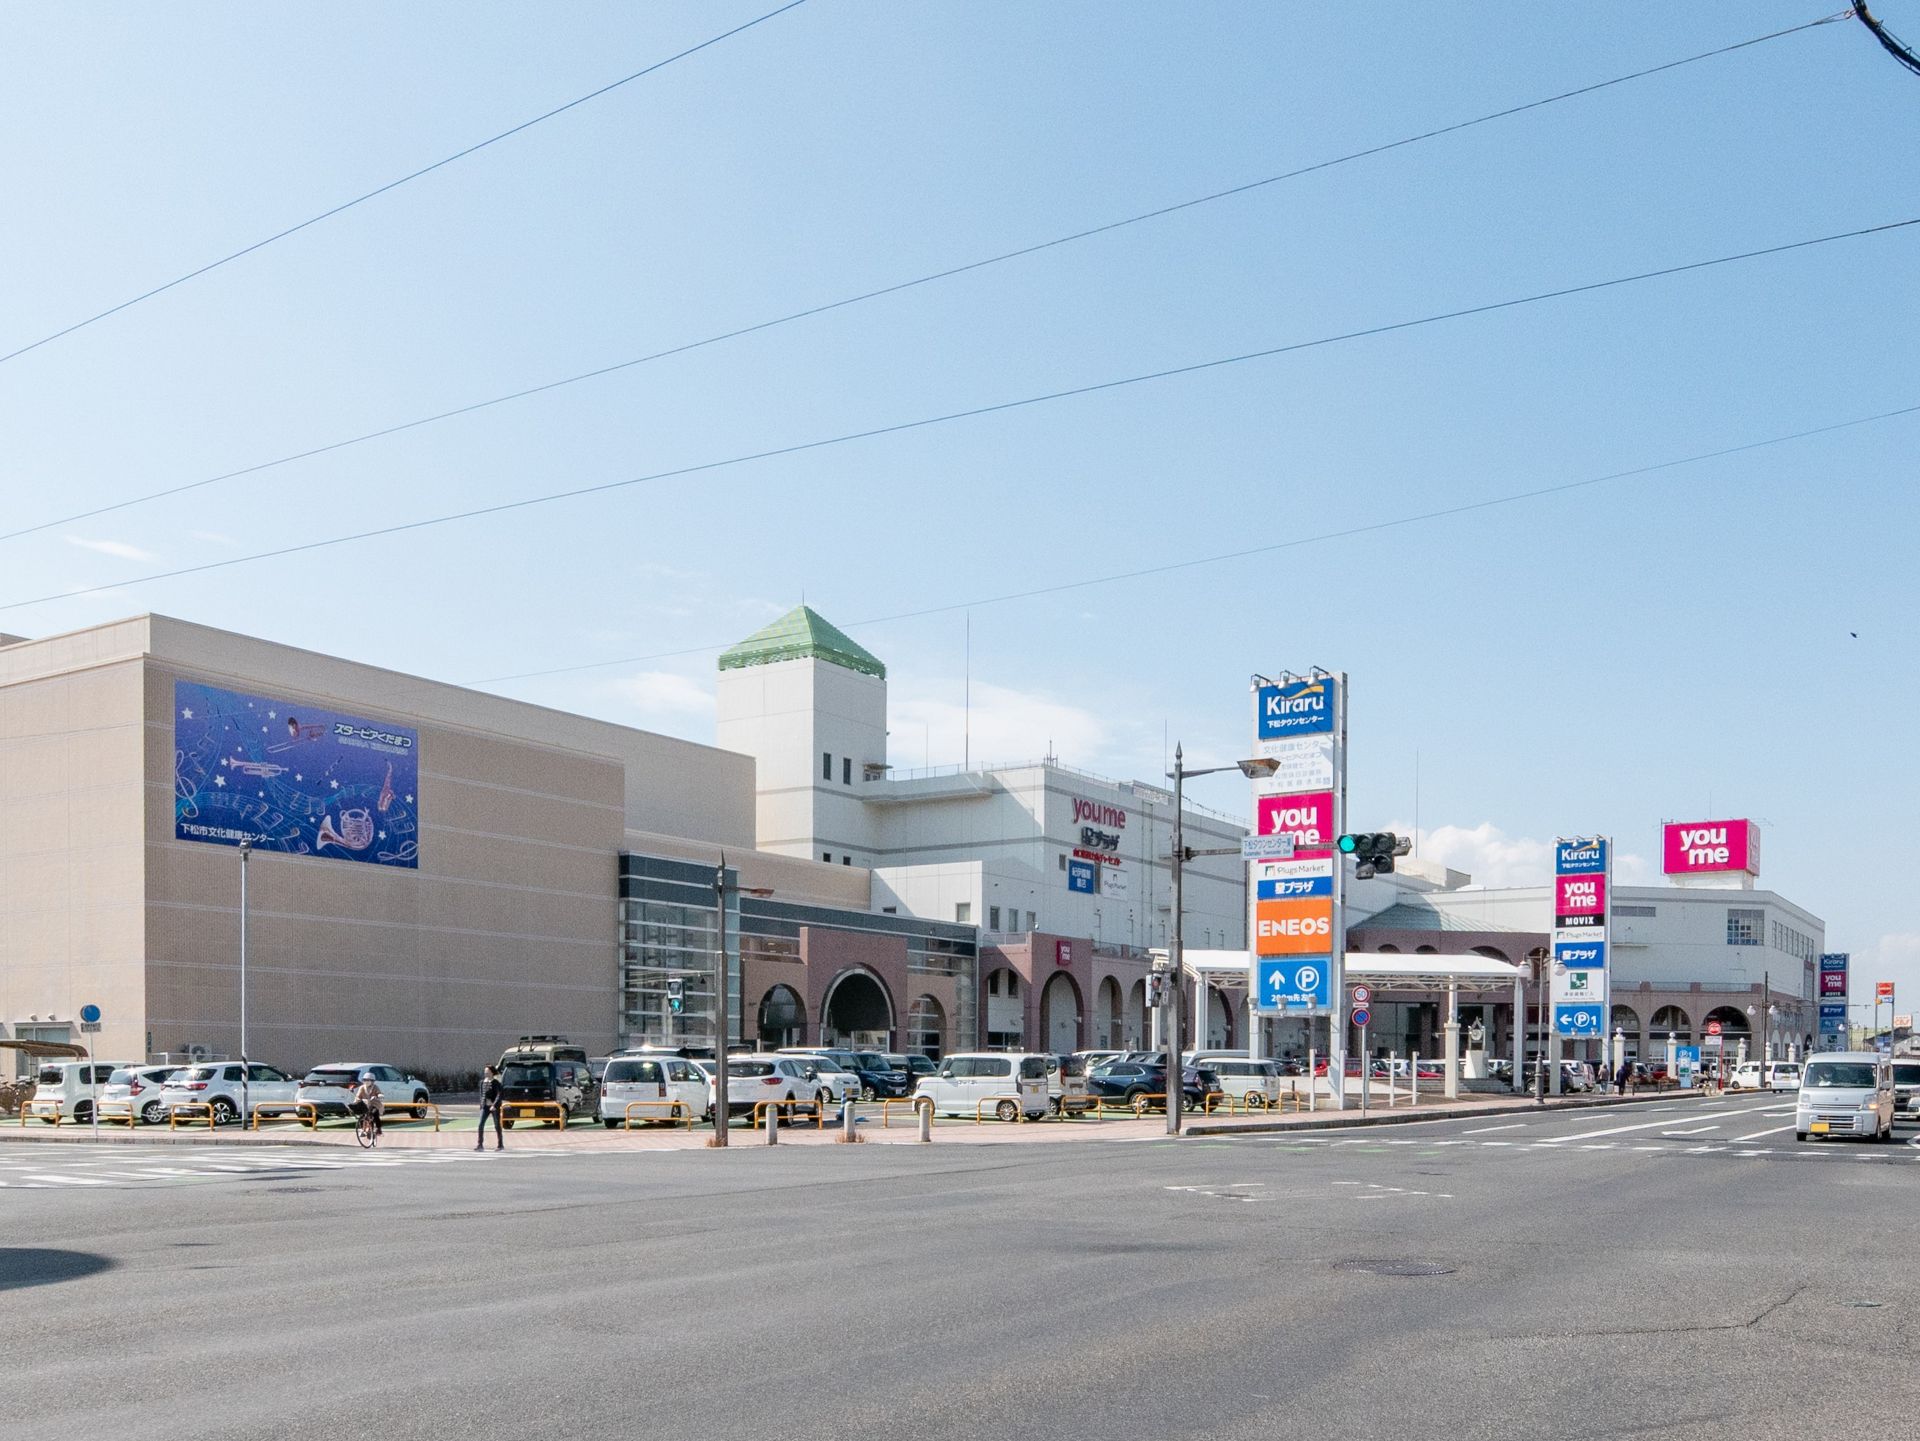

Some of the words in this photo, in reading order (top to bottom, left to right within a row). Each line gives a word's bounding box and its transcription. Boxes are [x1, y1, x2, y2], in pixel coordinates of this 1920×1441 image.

[1267, 695, 1324, 716] Kiraru
[1267, 716, 1324, 728] 下松タウンセンター
[334, 723, 412, 747] スターピアくだまつ
[1271, 806, 1317, 834] you
[180, 823, 275, 842] 下松市文化健康センター
[1680, 827, 1727, 851] you
[1561, 848, 1600, 861] Kiraru
[1689, 846, 1730, 865] me
[1564, 881, 1596, 898] you
[1569, 894, 1597, 907] me
[1258, 917, 1330, 936] ENEOS
[1565, 917, 1595, 926] MOVIX
[1825, 974, 1841, 983] you
[1828, 980, 1842, 988] me
[1591, 1015, 1597, 1026] 1
